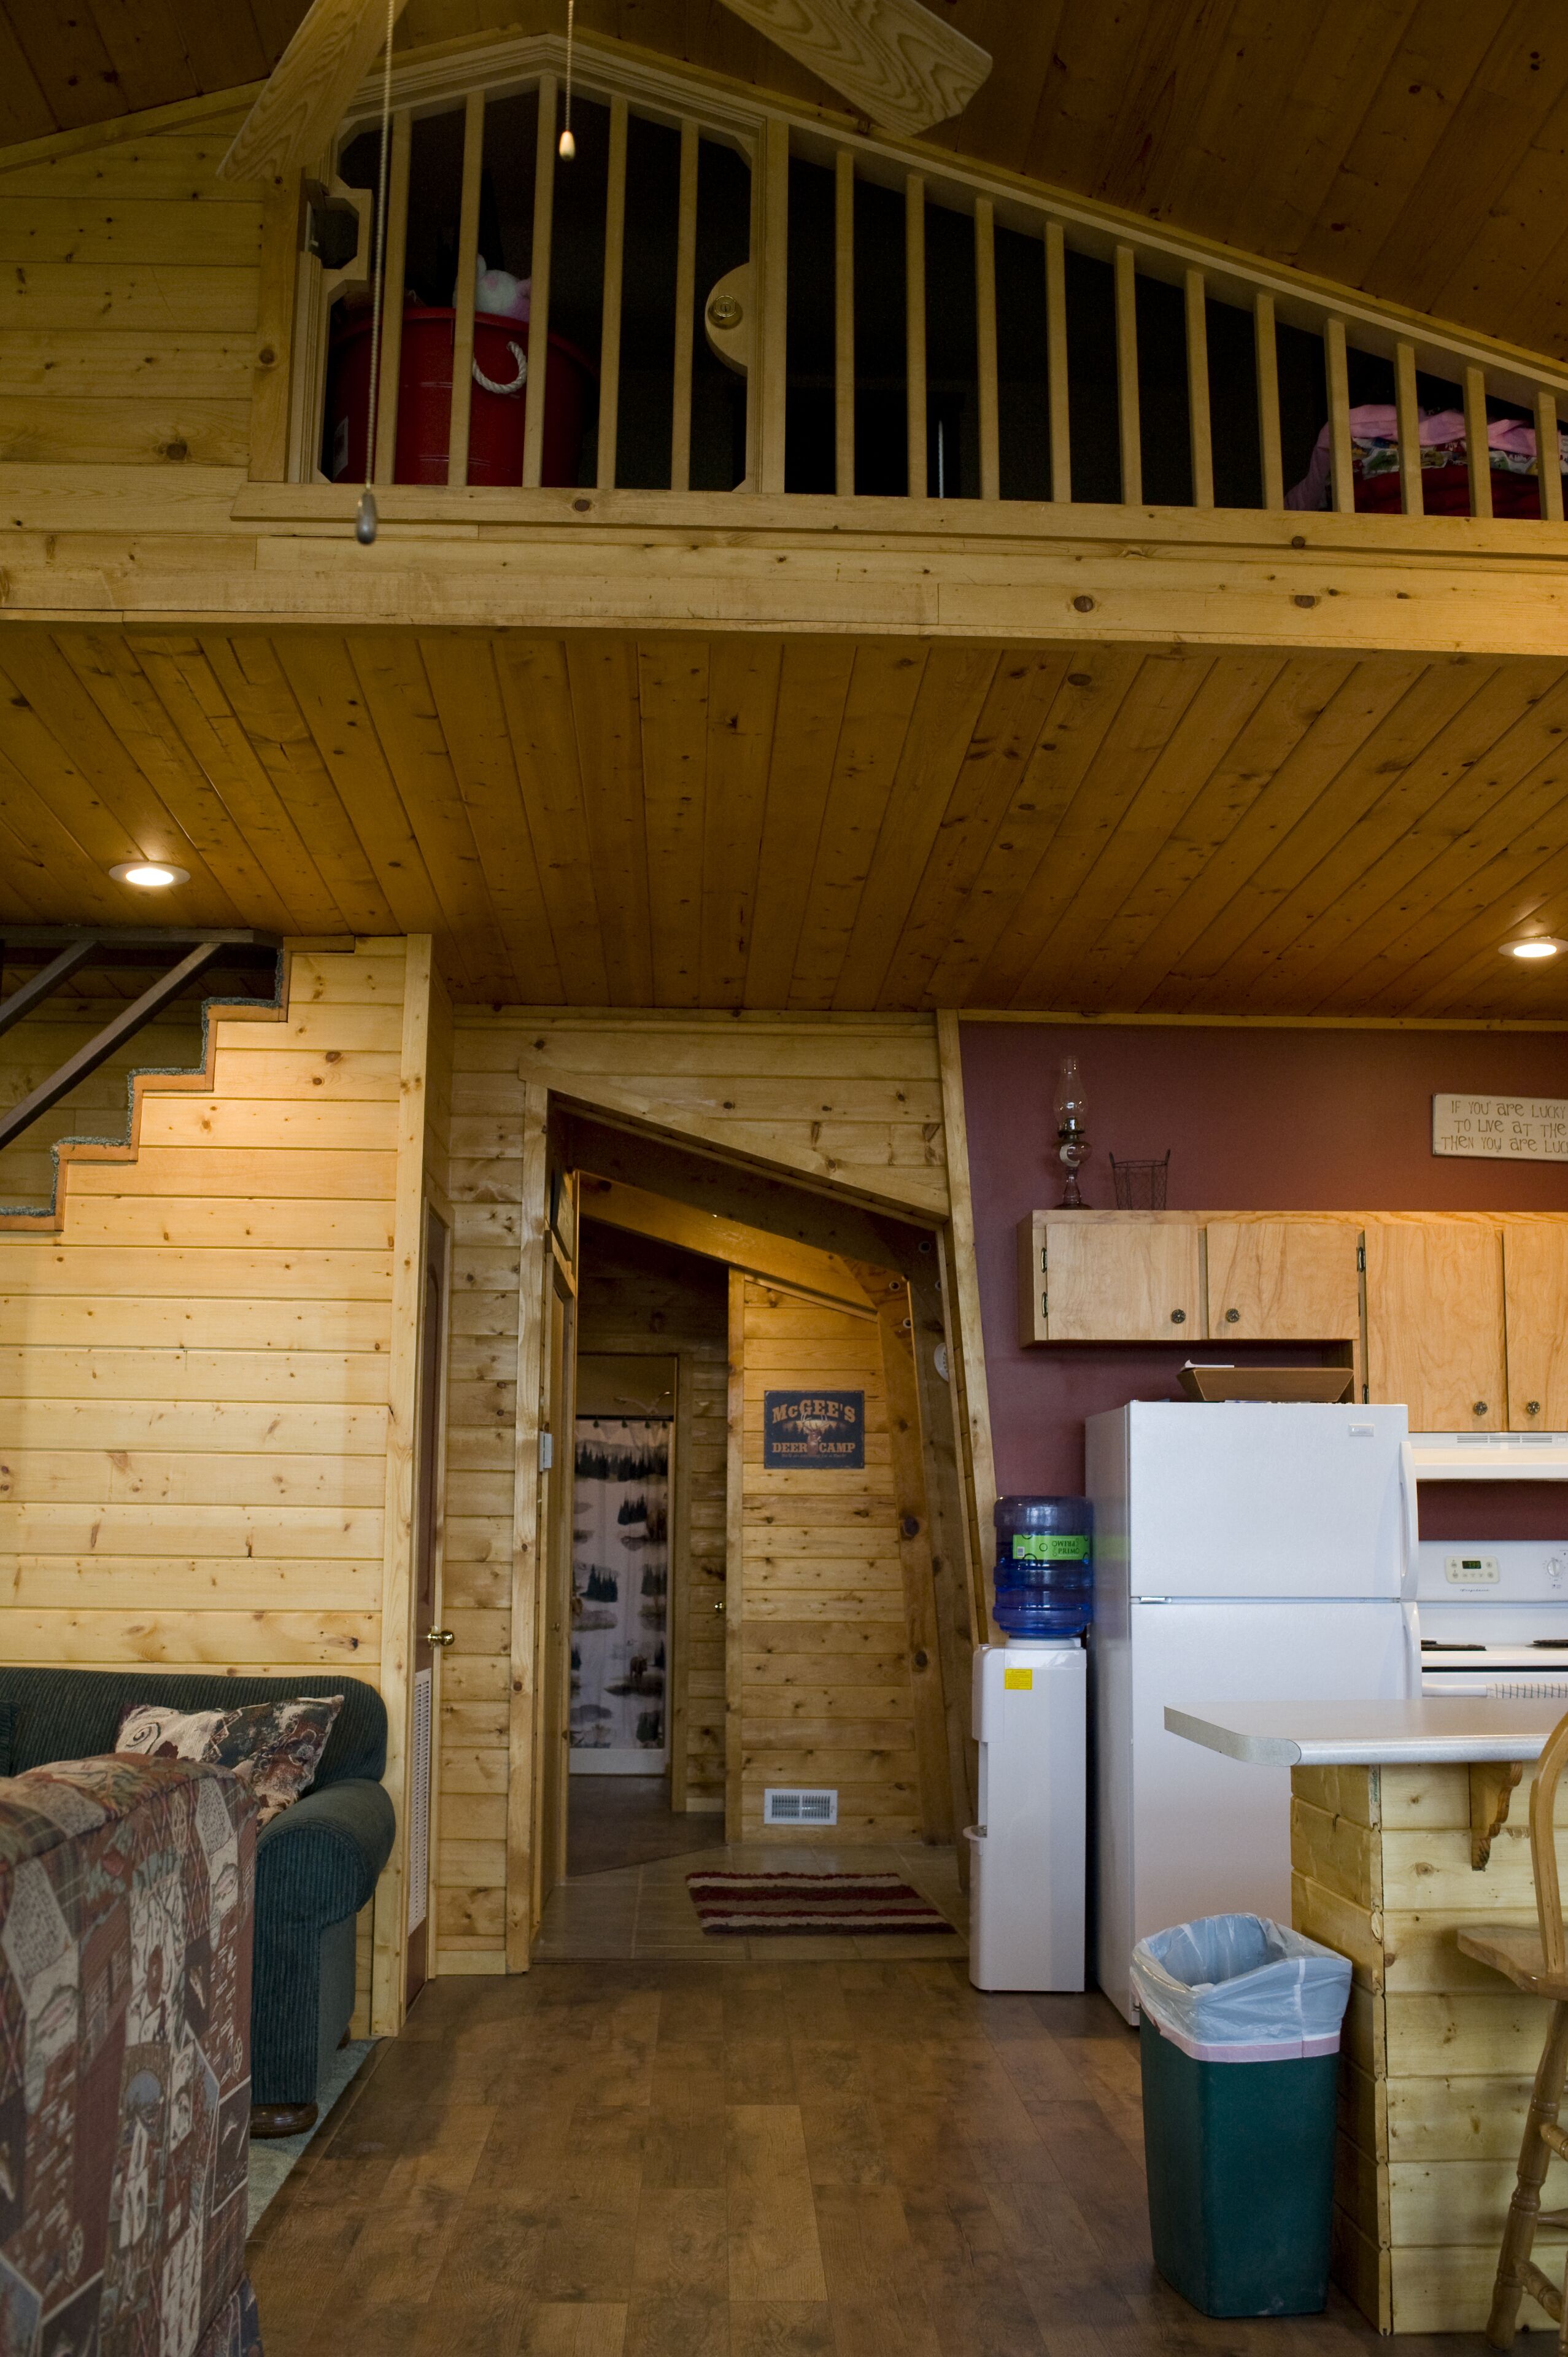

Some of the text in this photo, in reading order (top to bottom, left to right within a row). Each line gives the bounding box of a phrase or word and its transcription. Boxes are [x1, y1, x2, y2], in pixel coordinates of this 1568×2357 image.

[1451, 1100, 1566, 1120] IF YOU are LUCKY
[1454, 1118, 1471, 1133] TO
[1480, 1136, 1502, 1151] YOU
[1509, 1137, 1538, 1152] are
[1545, 1140, 1568, 1154] LUC
[772, 1399, 855, 1424] McGEE'S
[772, 1442, 856, 1453] DEER CAMP
